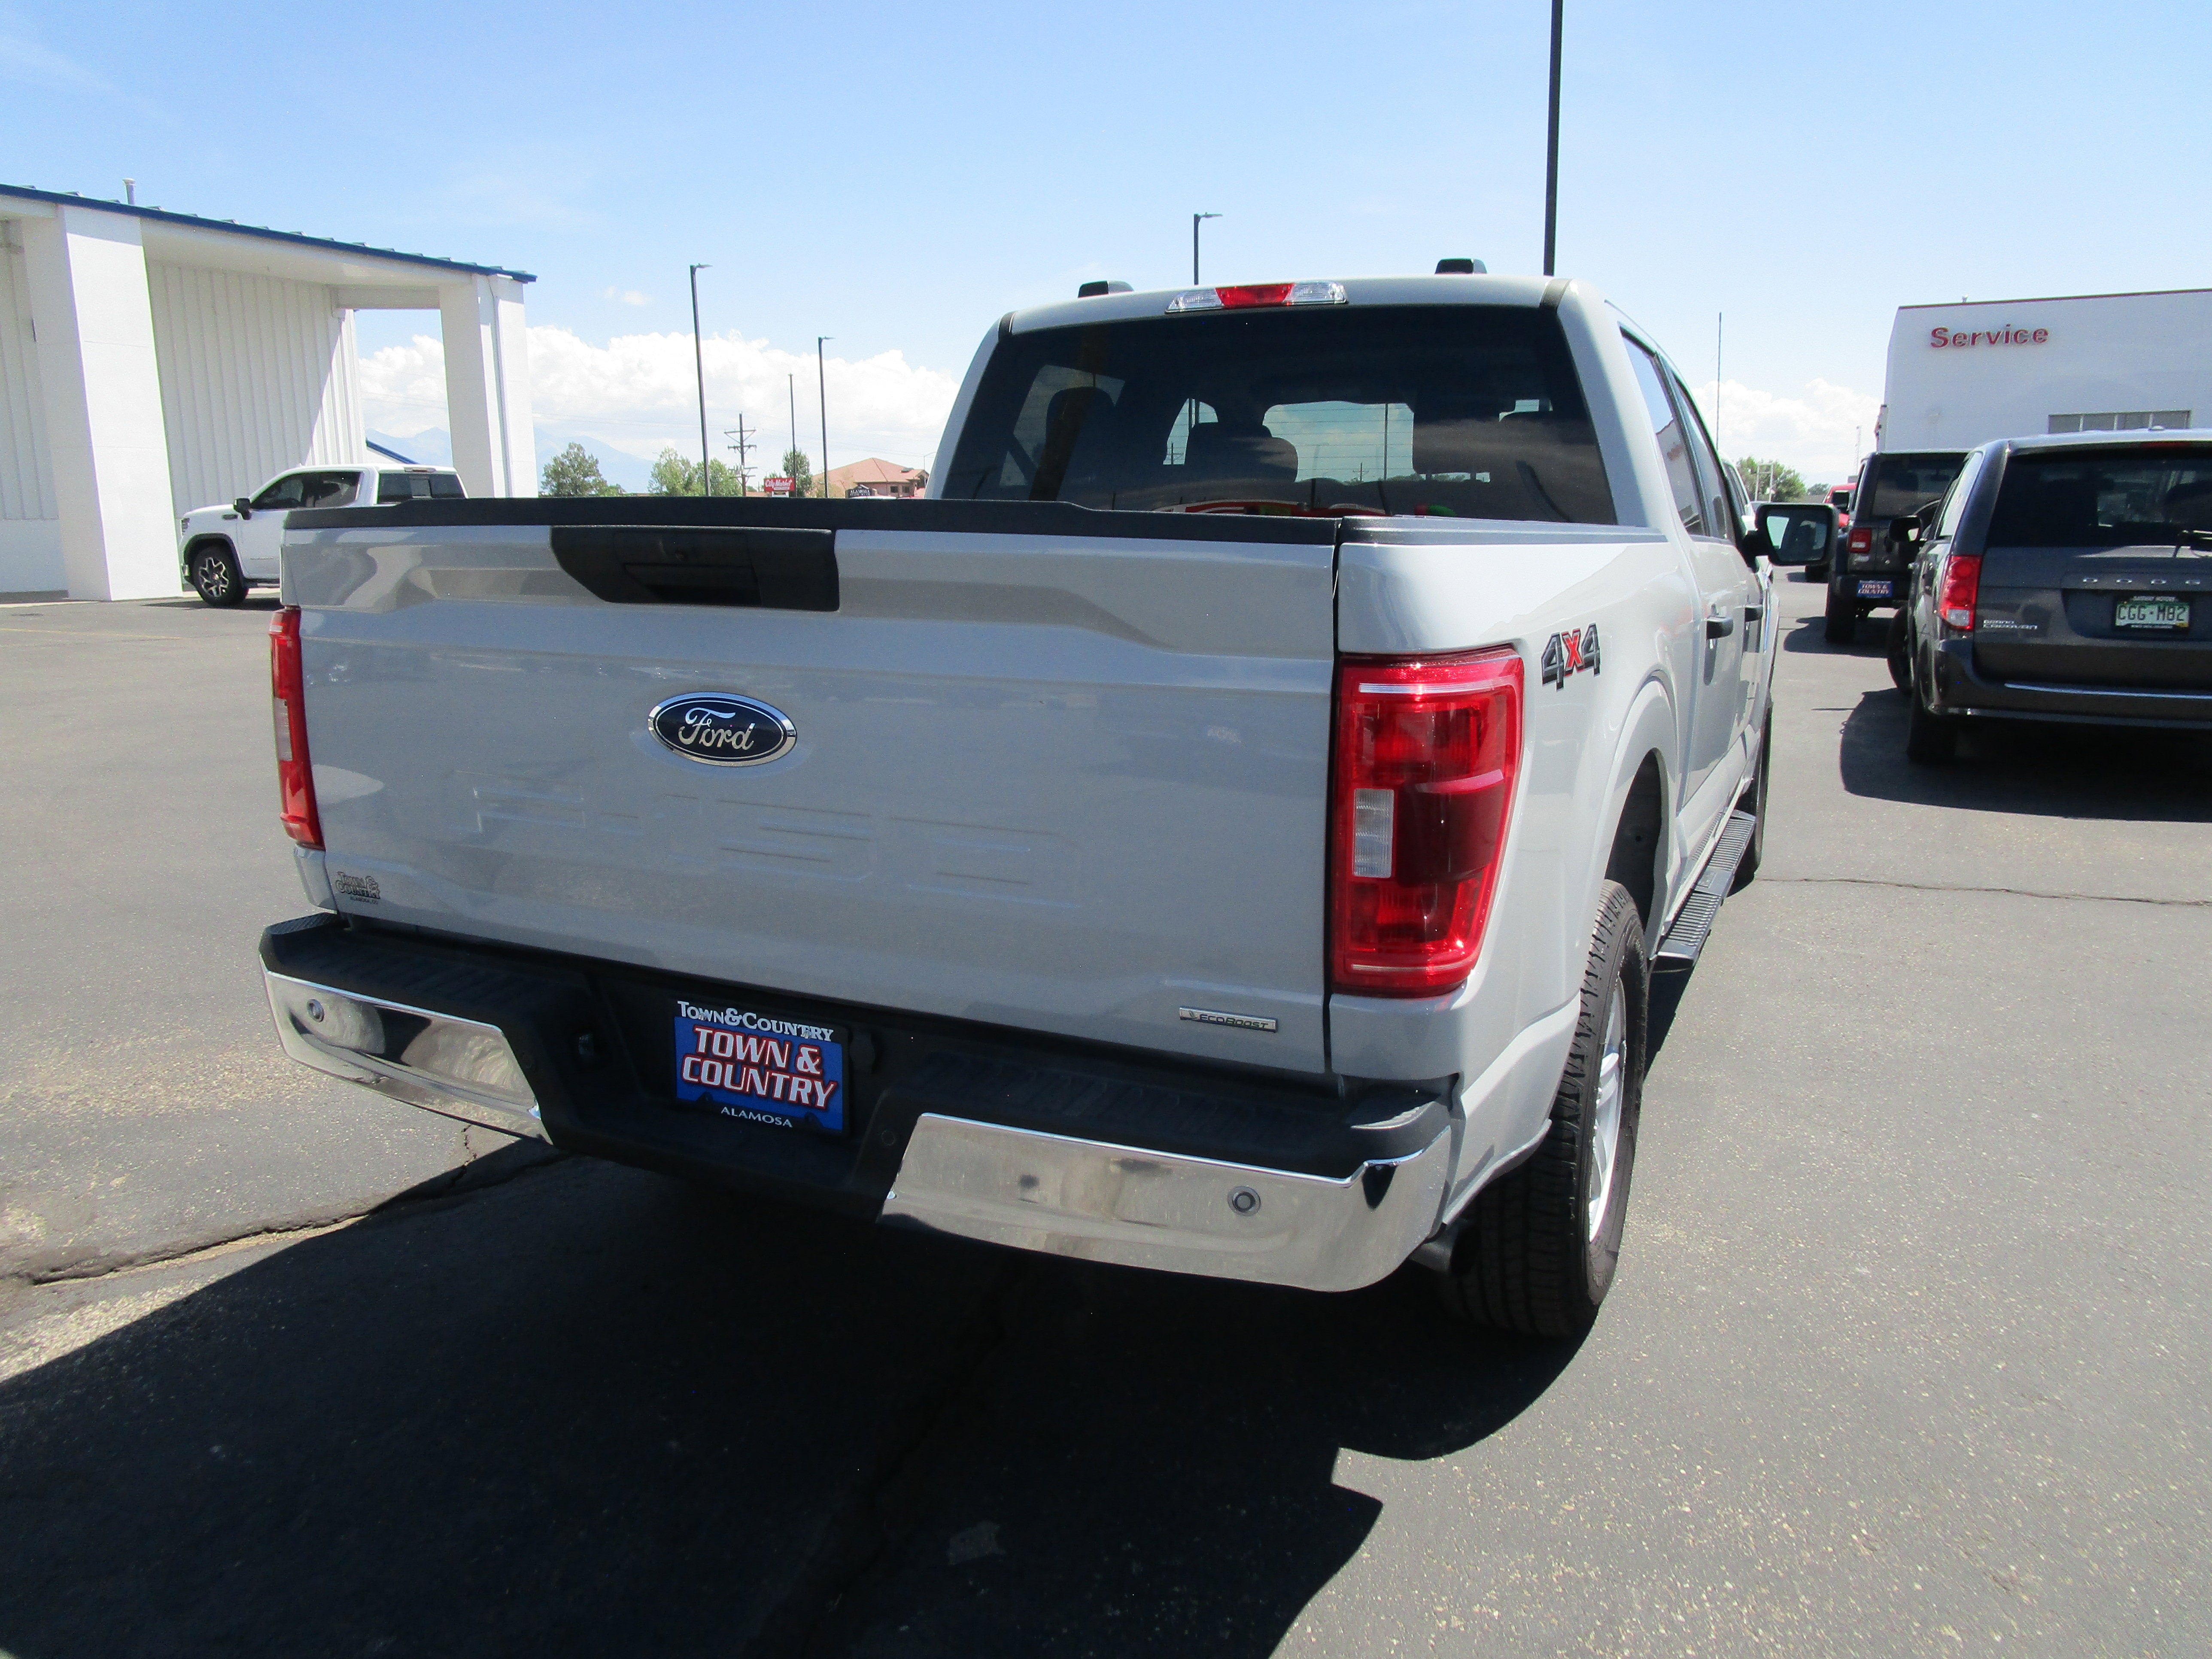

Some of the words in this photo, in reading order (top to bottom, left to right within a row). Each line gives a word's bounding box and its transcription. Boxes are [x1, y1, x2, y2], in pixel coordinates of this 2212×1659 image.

[1930, 323, 2049, 348] Service
[678, 707, 755, 750] Ford
[693, 1026, 789, 1069] TOWN
[796, 1046, 821, 1074] &
[682, 1056, 836, 1108] COUNTRY
[721, 1106, 793, 1128] ALAMOSA
